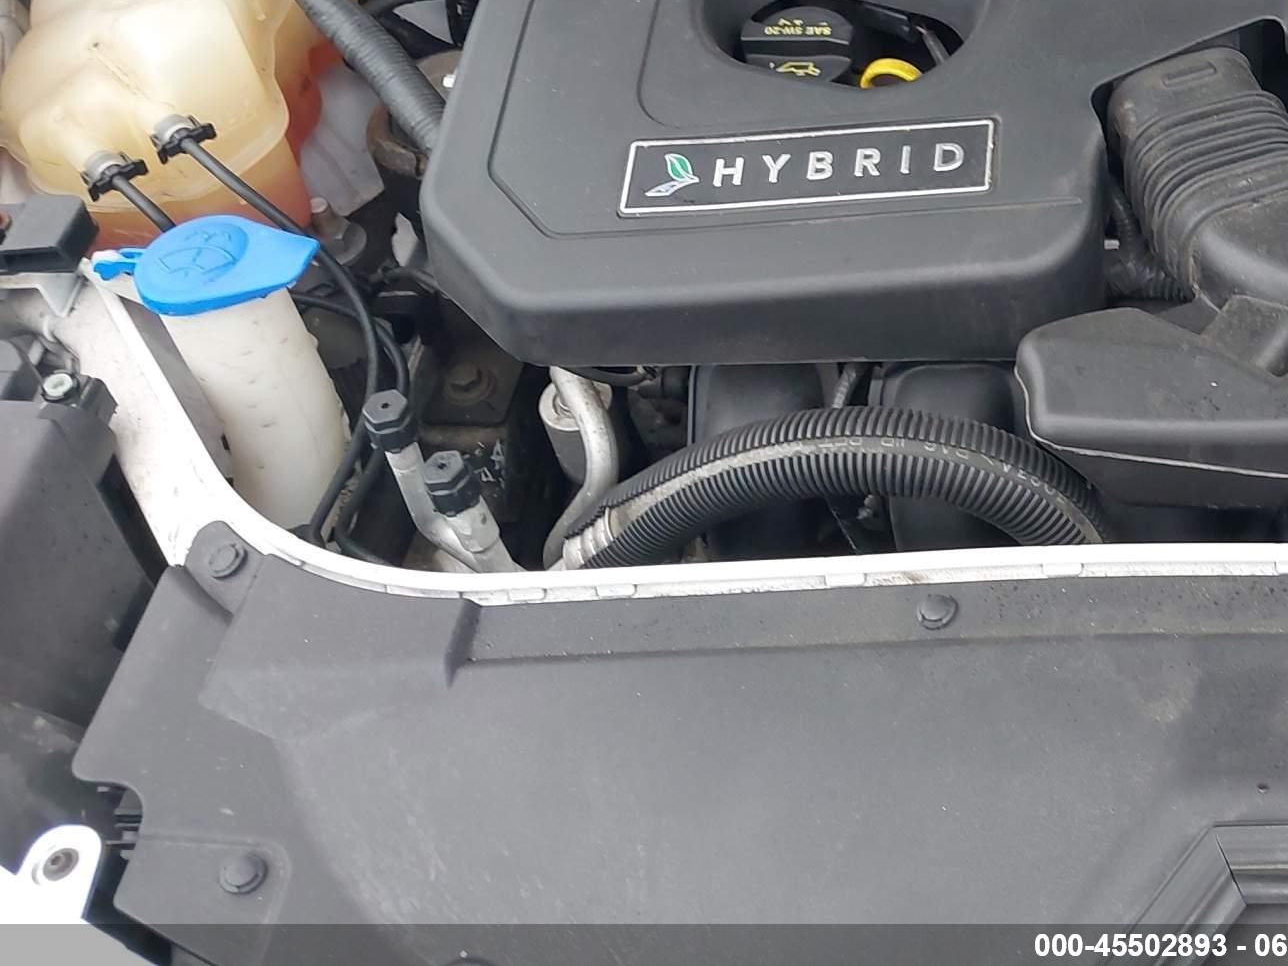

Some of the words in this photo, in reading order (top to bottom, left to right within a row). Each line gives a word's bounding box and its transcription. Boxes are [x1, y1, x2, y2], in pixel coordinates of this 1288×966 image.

[764, 26, 803, 36] 5W-20
[805, 26, 832, 36] SAE
[712, 143, 965, 187] HYBRID
